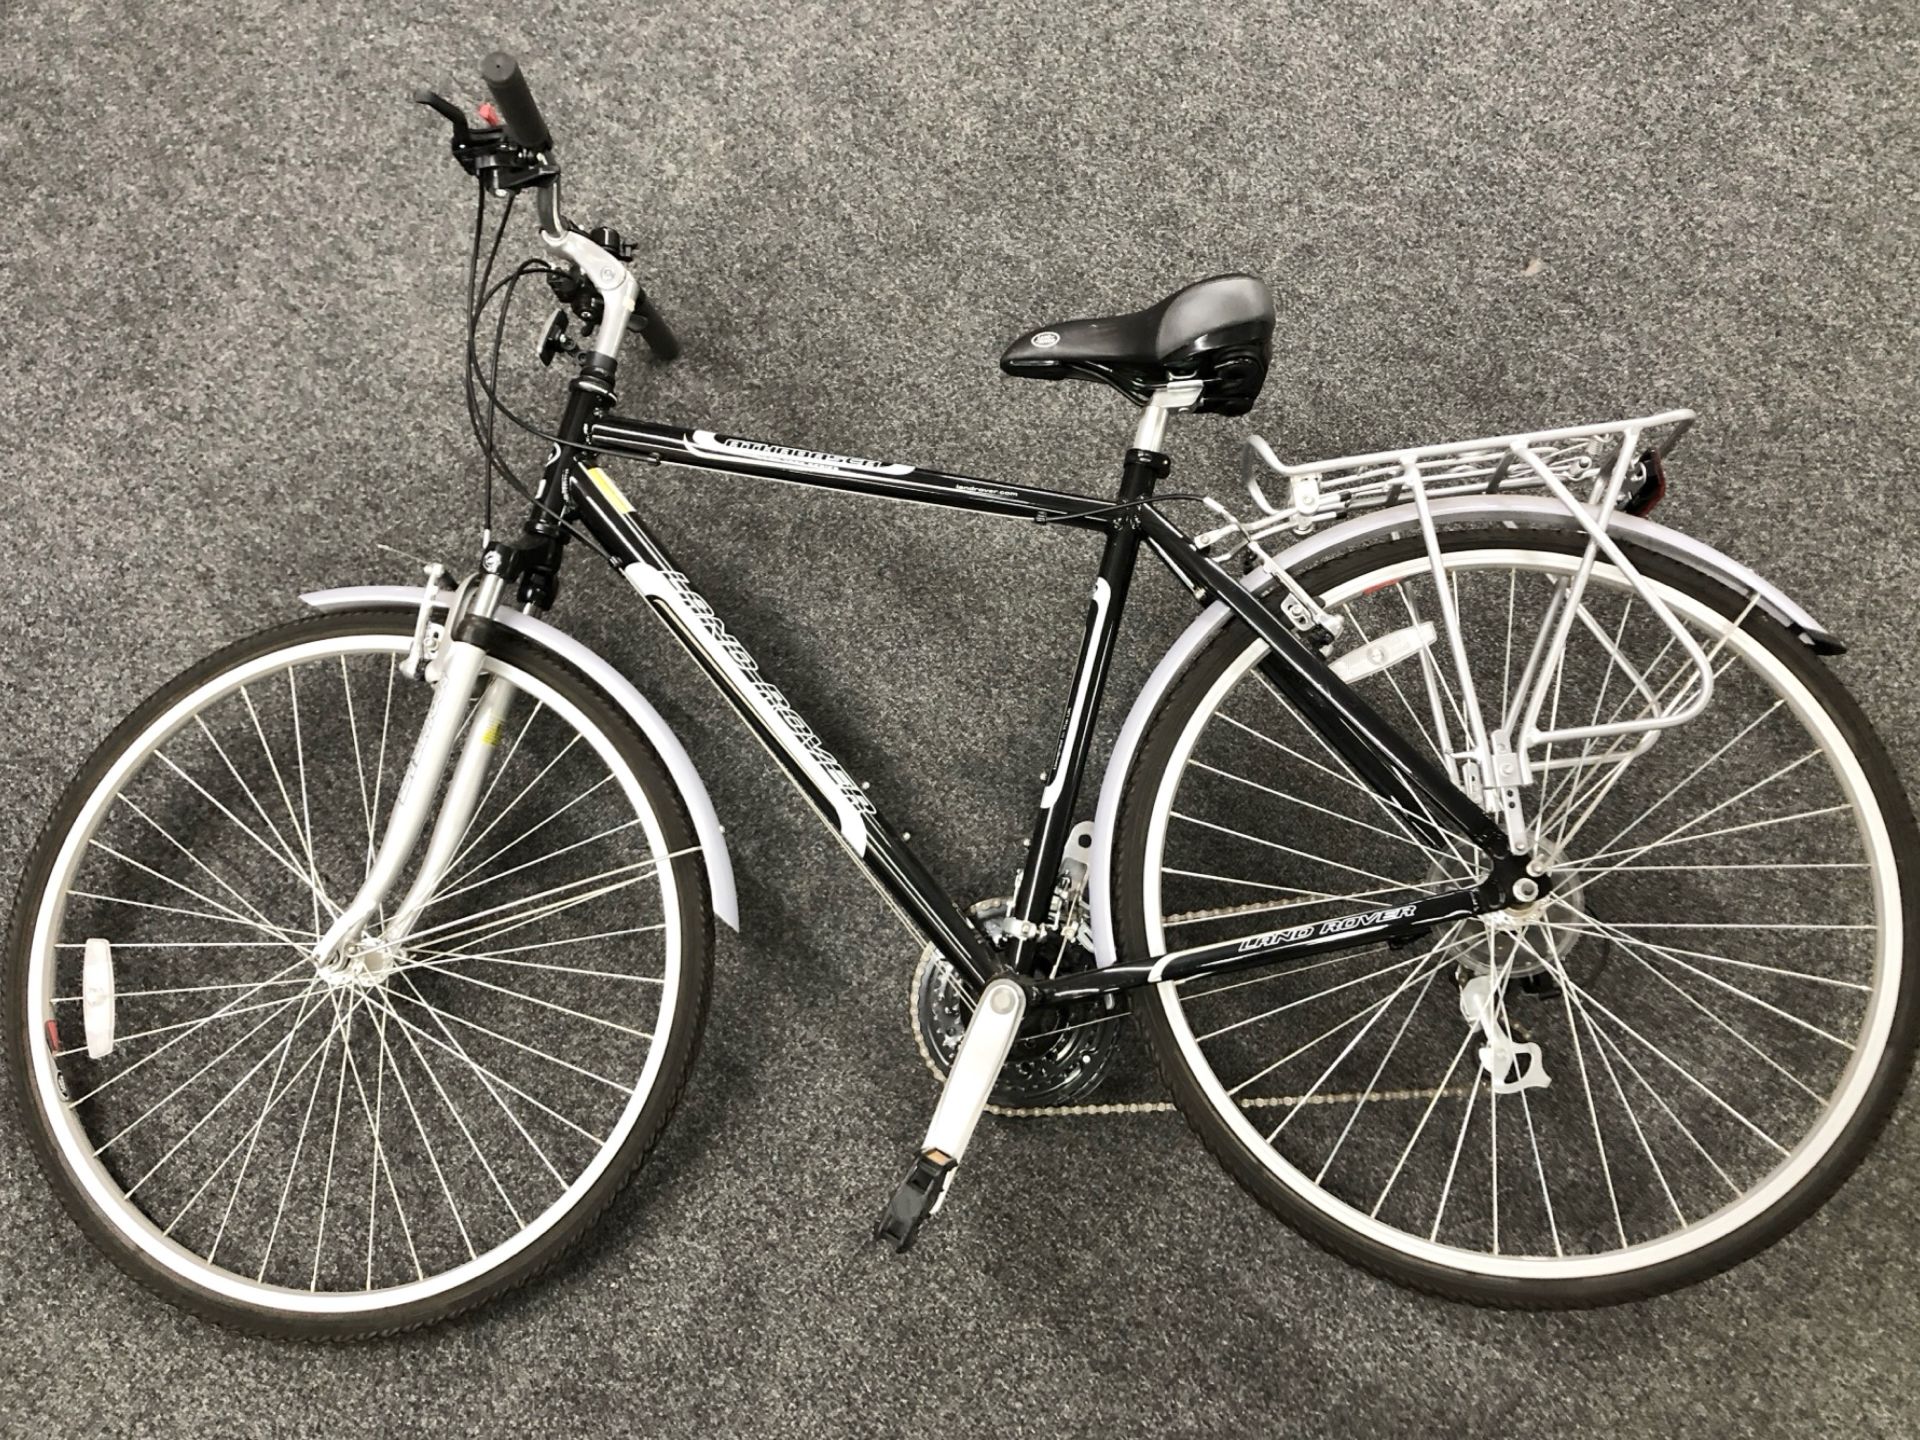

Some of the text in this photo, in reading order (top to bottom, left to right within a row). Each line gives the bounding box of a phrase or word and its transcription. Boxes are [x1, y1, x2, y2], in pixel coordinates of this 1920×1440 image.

[656, 570, 877, 815] LAND ROVER
[1238, 904, 1417, 952] LAND ROVER
